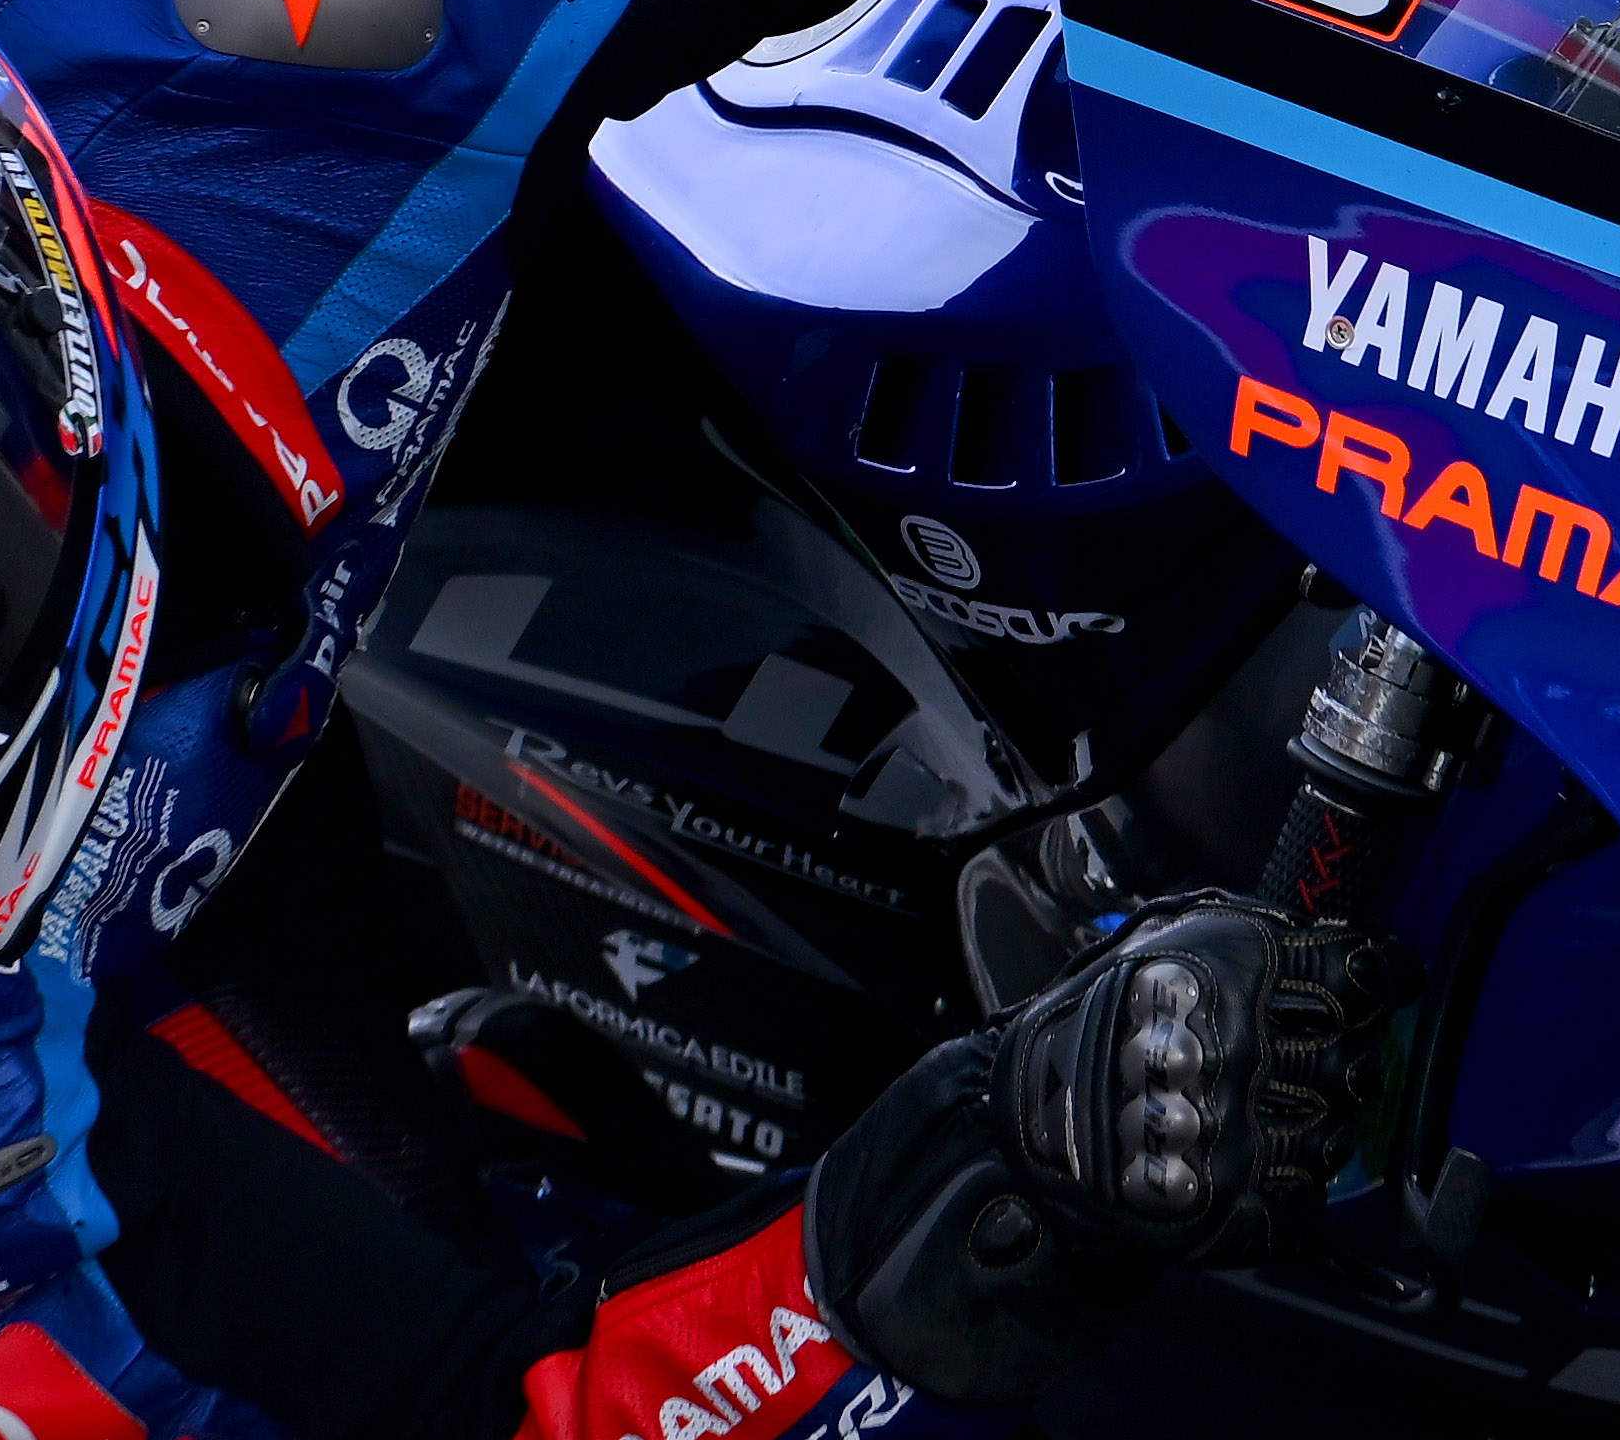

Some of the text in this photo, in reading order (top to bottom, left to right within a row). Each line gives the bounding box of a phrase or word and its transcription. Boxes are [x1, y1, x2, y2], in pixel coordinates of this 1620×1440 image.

[376, 320, 477, 505] PRAMAC
[75, 574, 156, 790] PRAMAC
[889, 572, 1126, 645] scoscuro
[483, 719, 906, 910] Revs Your Heart
